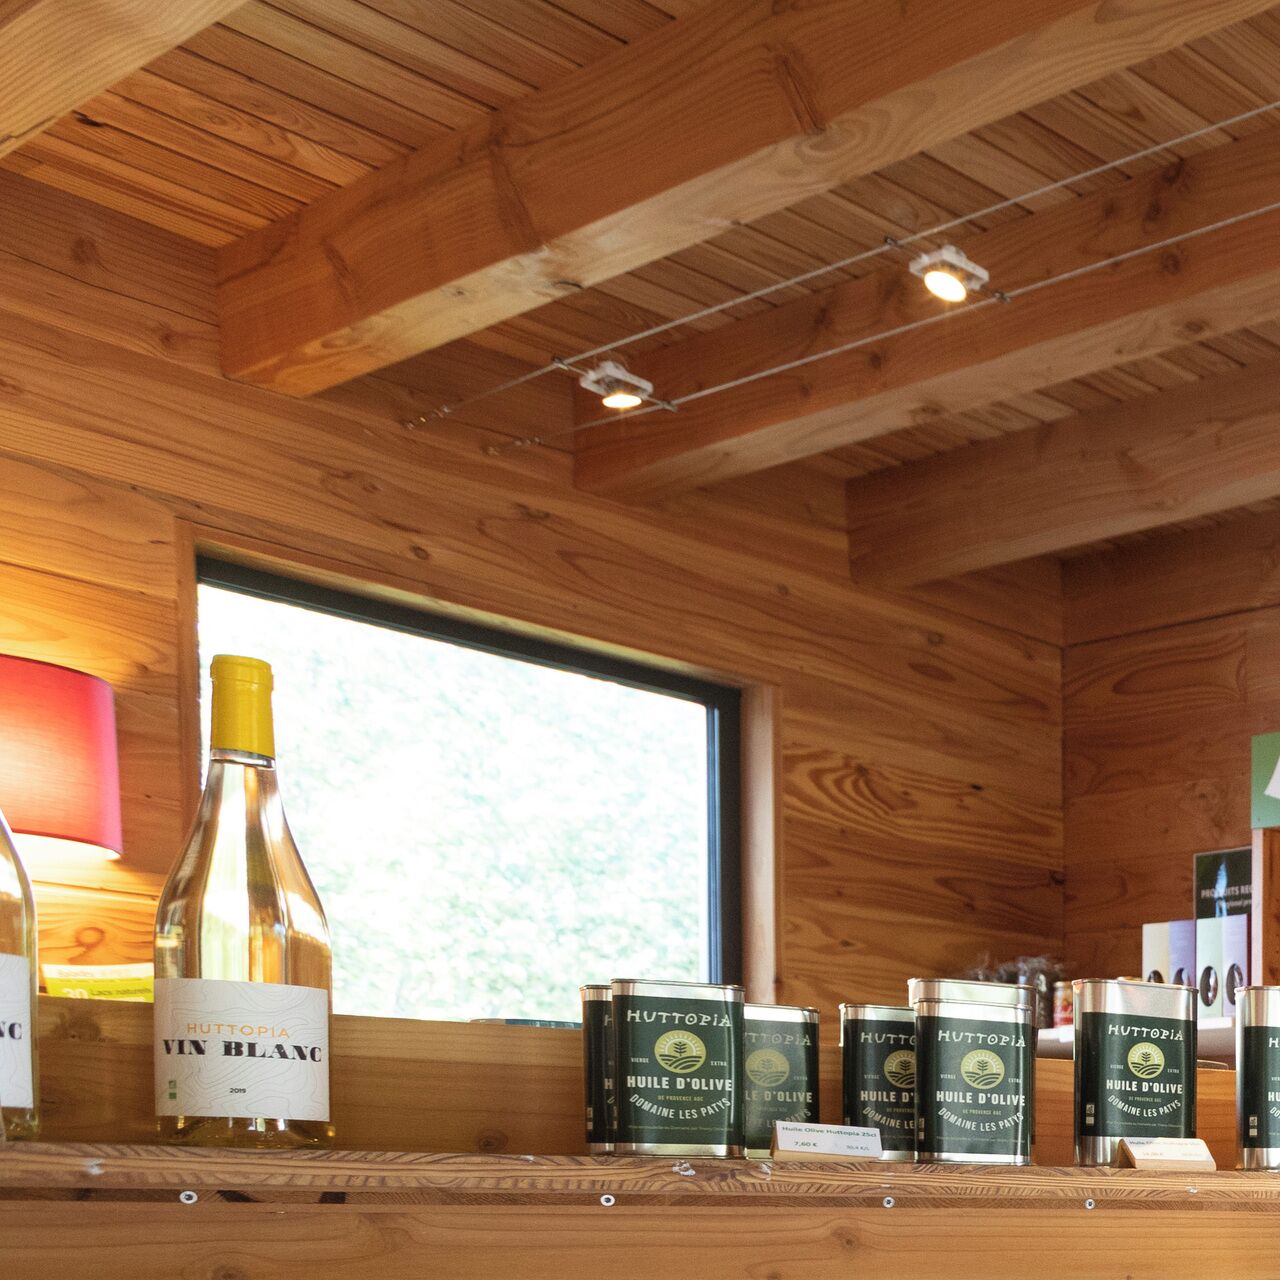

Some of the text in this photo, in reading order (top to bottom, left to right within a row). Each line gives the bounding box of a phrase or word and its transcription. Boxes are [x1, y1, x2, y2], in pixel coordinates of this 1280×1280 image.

[627, 1010, 732, 1027] HUTTOPIA
[188, 1023, 288, 1038] HUTTOPIA
[938, 1030, 1026, 1047] HUTTOPIA
[1108, 1025, 1184, 1040] HUTTOPIA
[163, 1039, 322, 1062] VIN BLANC
[627, 1076, 732, 1091] HUILE D'OLIVE
[1107, 1079, 1182, 1094] HUILE D'OLIVE
[860, 1090, 896, 1102] HUILE
[937, 1091, 1025, 1106] HUILE D'OLIVE
[630, 1094, 731, 1120] DOMAINE LES PATYS
[1108, 1095, 1181, 1117] DOMAINE LES PATYS
[938, 1108, 996, 1132] DOMAINE LES
